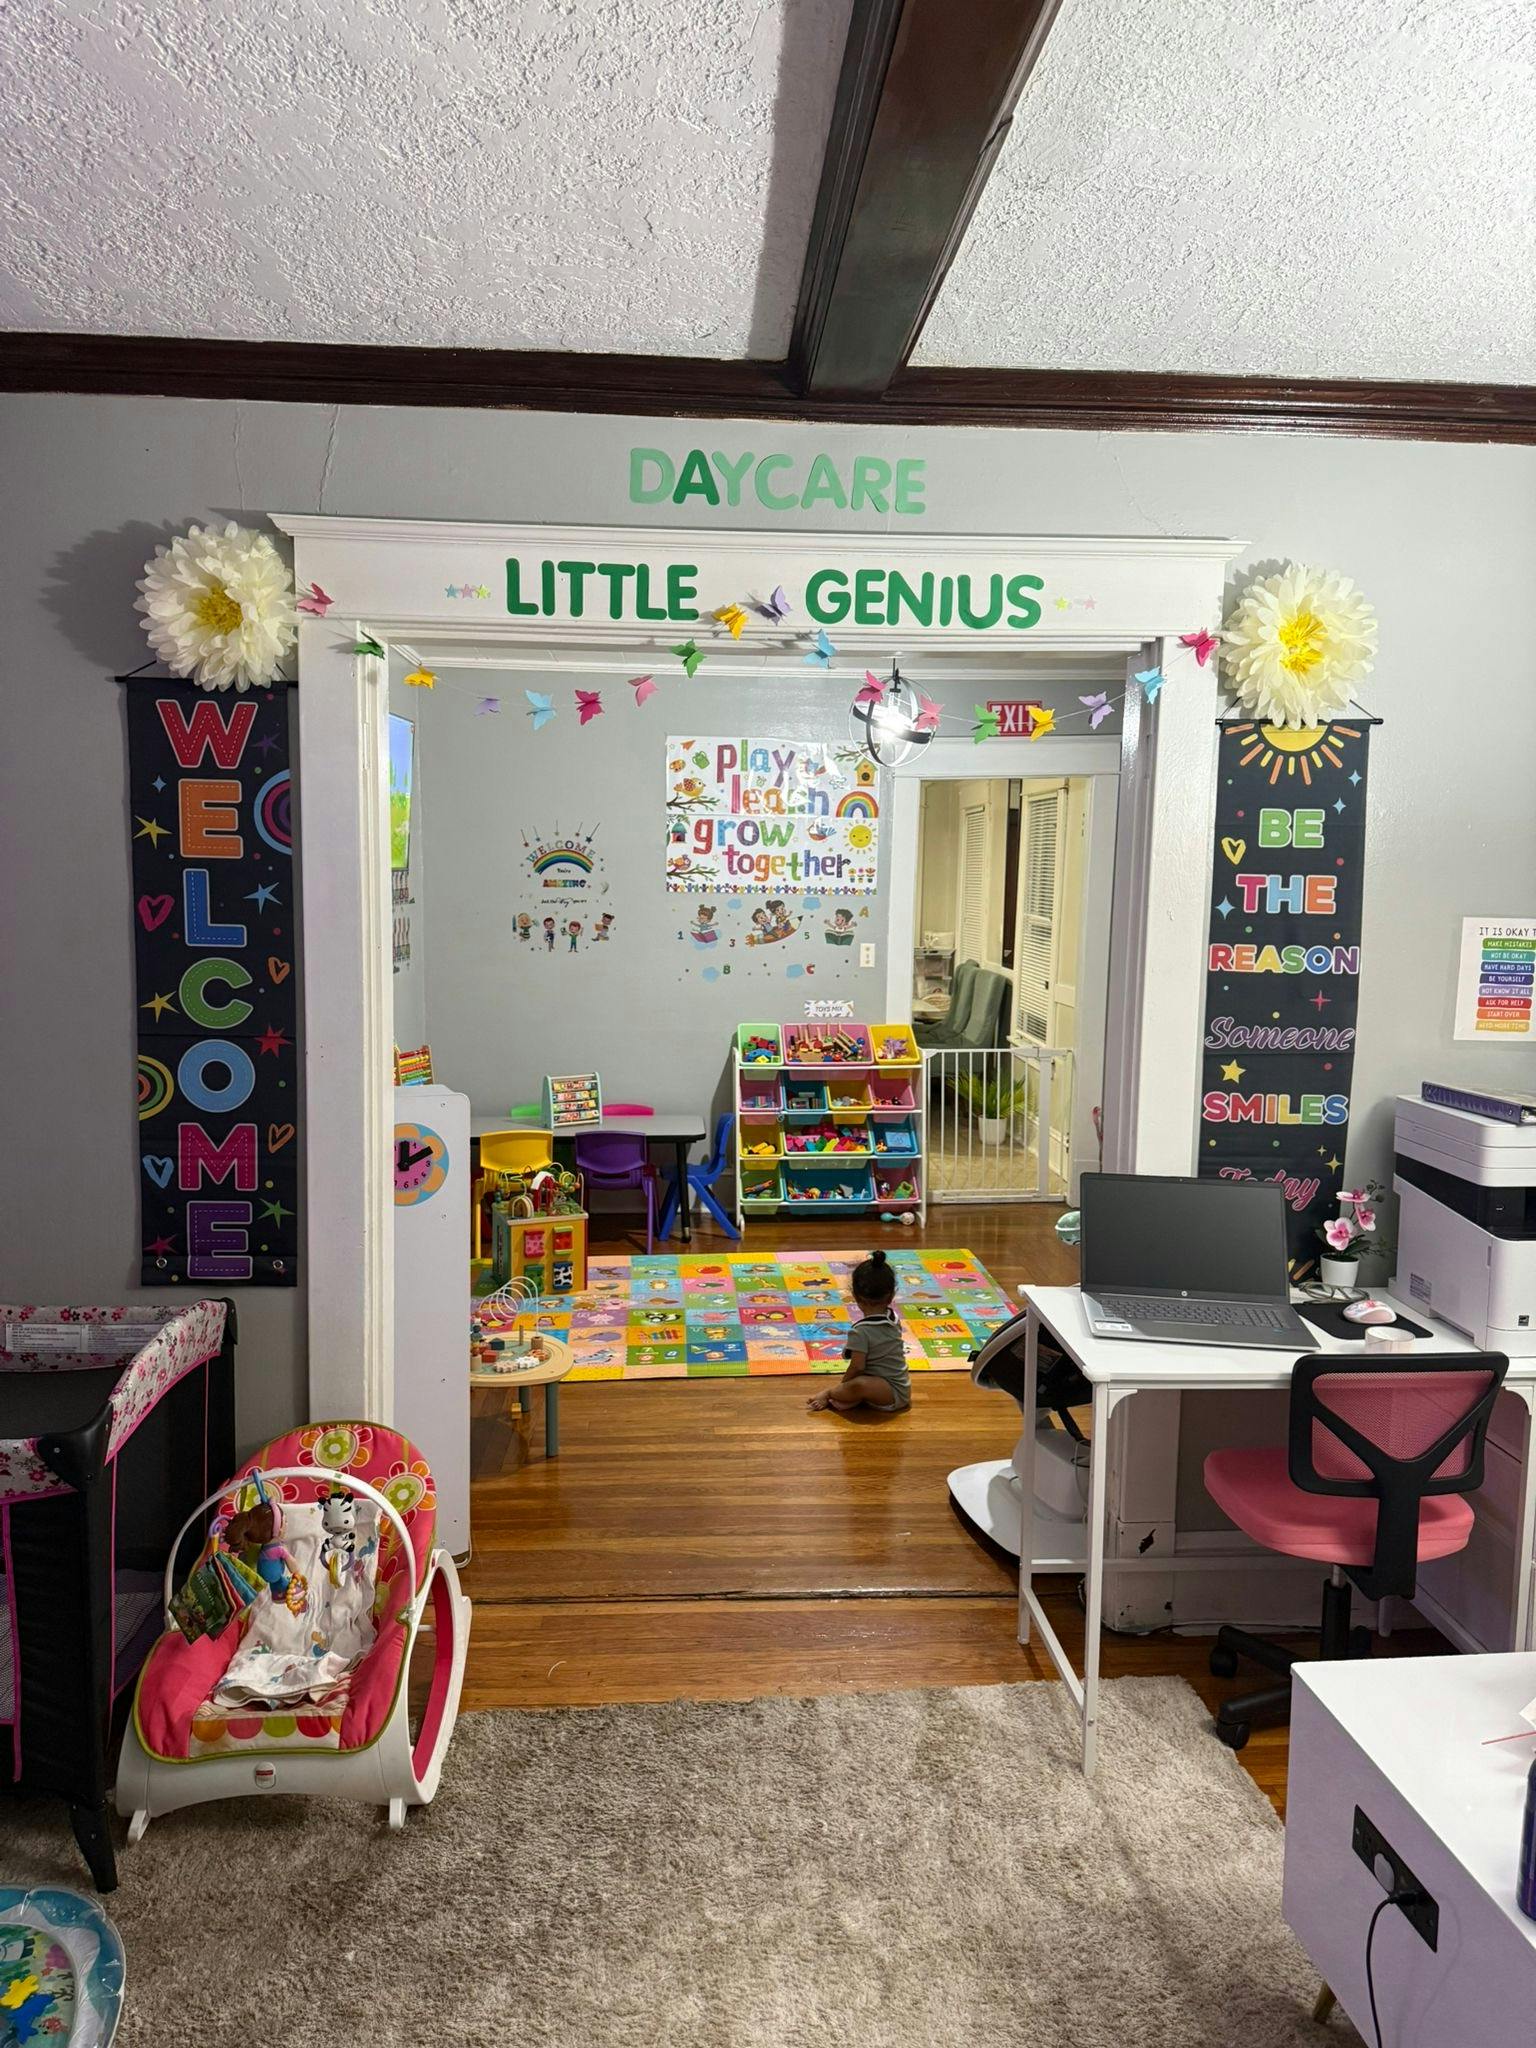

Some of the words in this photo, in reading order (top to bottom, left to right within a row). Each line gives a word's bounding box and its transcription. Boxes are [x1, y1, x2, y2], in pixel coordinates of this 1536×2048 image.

[629, 447, 926, 514] DAYCARE
[505, 558, 699, 621] LITTLE
[805, 569, 1045, 629] GENIUS
[717, 739, 796, 788] play
[693, 819, 795, 855] grow
[1258, 809, 1325, 849] BE
[526, 840, 596, 863] WELCOME
[722, 844, 851, 882] together
[1235, 874, 1337, 914] THE
[1480, 926, 1489, 936] IT
[1493, 927, 1502, 936] IS
[1505, 927, 1529, 936] OKAY
[1208, 944, 1359, 975] REASON
[156, 699, 259, 1280] WELCOME
[1203, 1017, 1356, 1051] Someone
[1202, 1092, 1349, 1126] SMILES
[403, 1181, 409, 1189] 6
[1219, 1167, 1320, 1211] Tay
